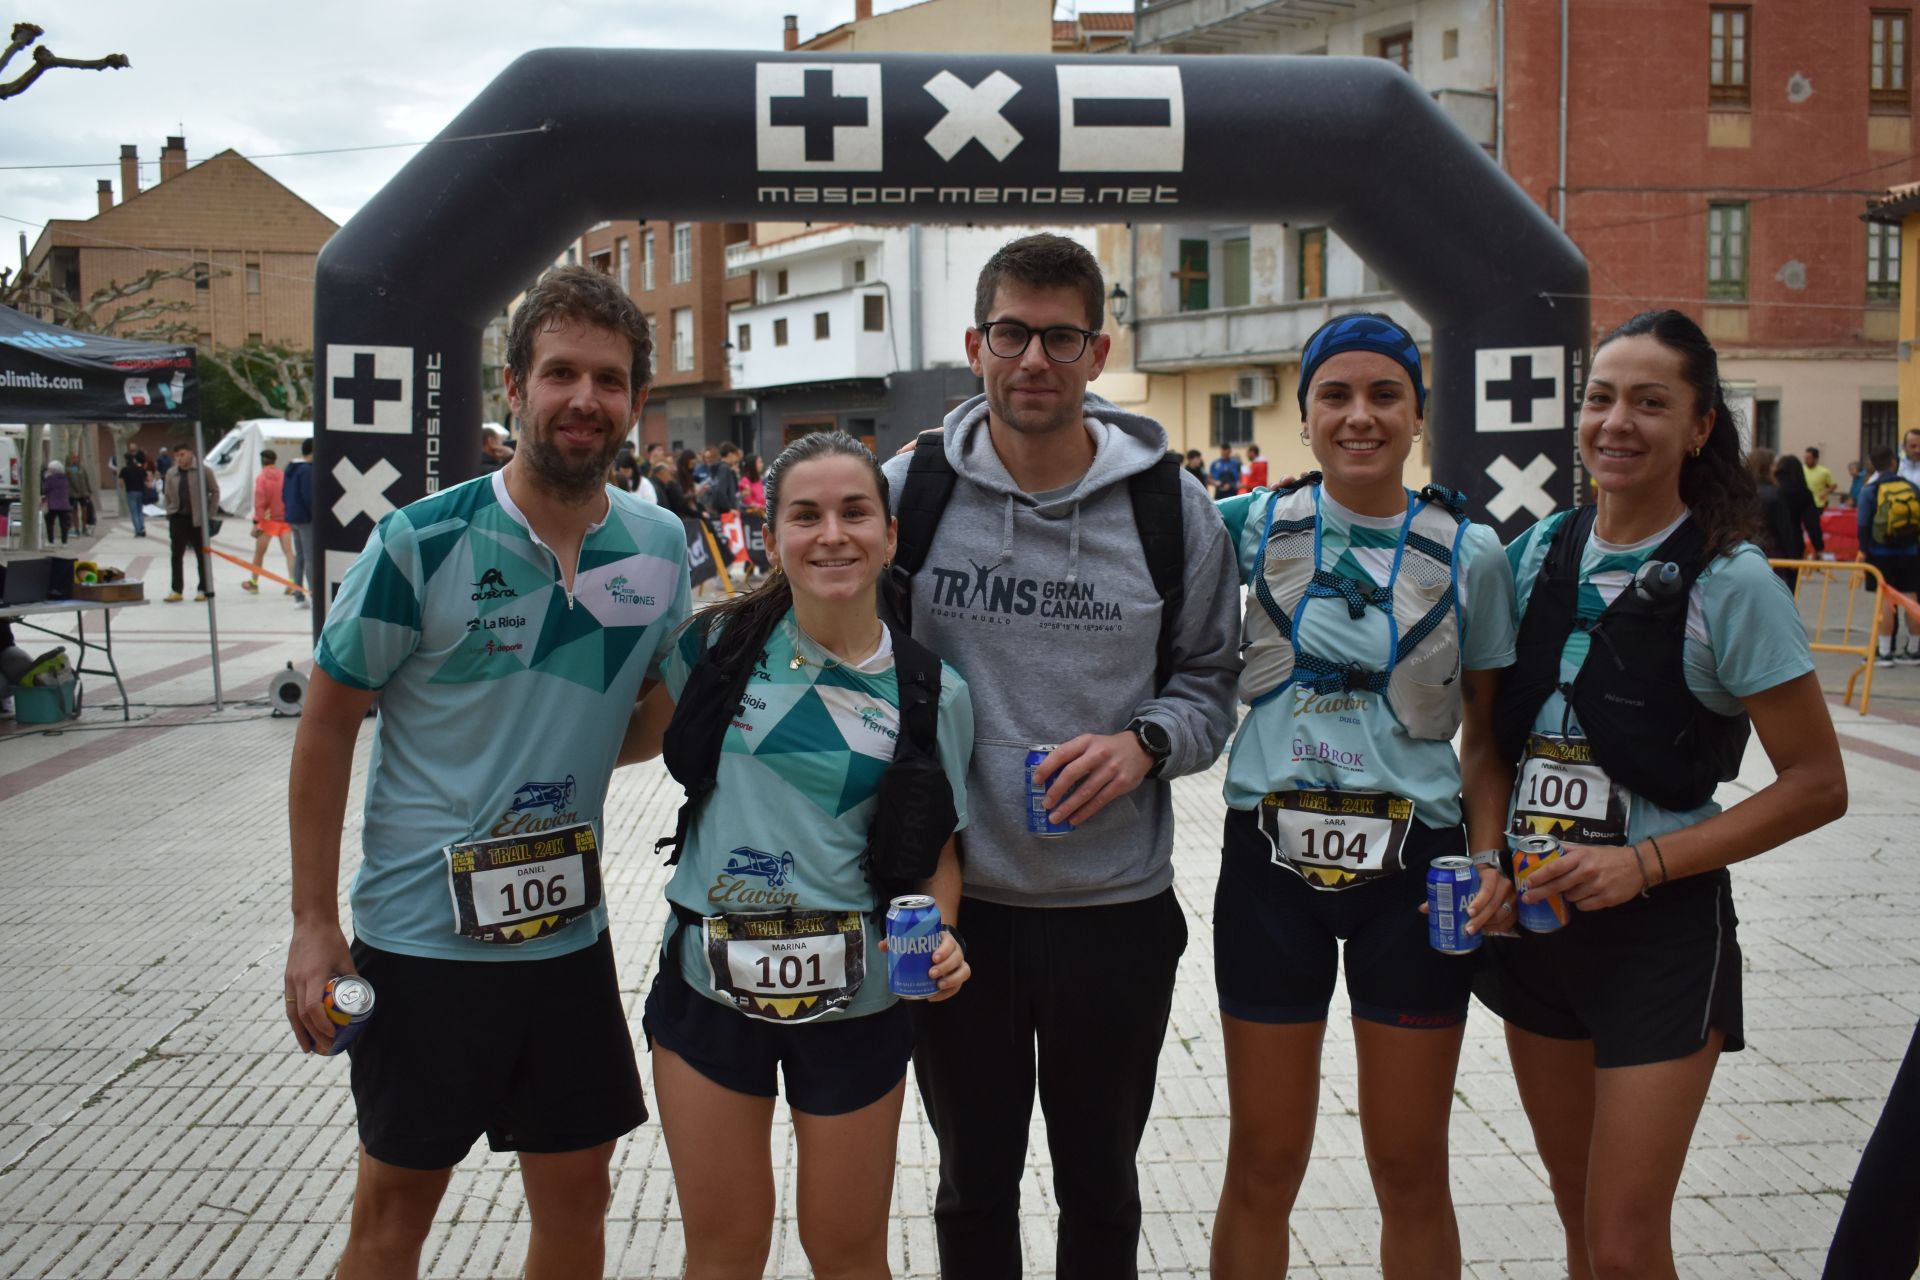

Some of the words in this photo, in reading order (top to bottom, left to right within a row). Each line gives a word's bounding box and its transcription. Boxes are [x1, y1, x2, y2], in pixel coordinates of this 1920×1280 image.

[757, 185, 1179, 206] maspormenos.net
[612, 592, 655, 606] TRITONES
[1042, 582, 1095, 601] GRAN
[971, 614, 1011, 625] NUBLO
[1040, 599, 1122, 621] CANARIA
[483, 619, 498, 630] La
[498, 615, 526, 629] Rioja
[739, 692, 767, 711] Rioja
[1558, 743, 1590, 762] 24K
[1528, 773, 1588, 811] 100
[1341, 798, 1375, 815] 24K
[1324, 818, 1347, 827] SARA
[488, 843, 531, 865] TRAIL
[534, 837, 565, 858] 24K
[1300, 828, 1368, 864] 104
[517, 865, 547, 877] DANIEL
[500, 874, 567, 917] 106
[793, 916, 825, 934] 24K
[772, 942, 807, 952] MARINA
[755, 953, 826, 989] 101
